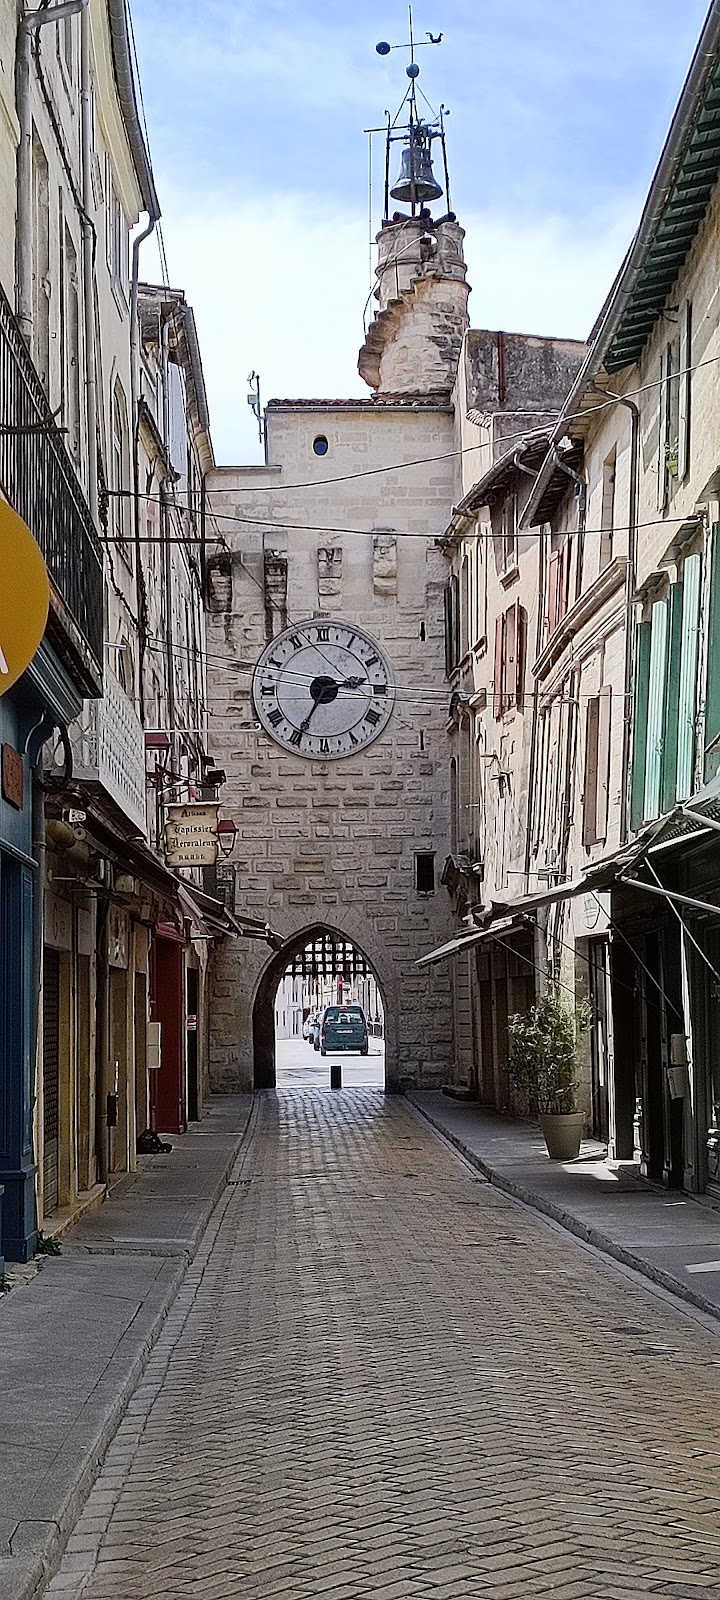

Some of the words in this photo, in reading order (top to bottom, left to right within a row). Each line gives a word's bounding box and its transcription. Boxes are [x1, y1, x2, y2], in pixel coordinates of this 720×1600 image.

[317, 627, 330, 642] XII
[289, 635, 303, 650] XI
[268, 657, 283, 668] X
[365, 656, 378, 667] II
[262, 685, 275, 696] IX
[373, 685, 386, 694] III
[267, 708, 284, 728] VIII
[287, 730, 302, 748] VII
[320, 738, 330, 752] VI
[181, 809, 206, 818] Artisan
[173, 823, 213, 835] Tapissier
